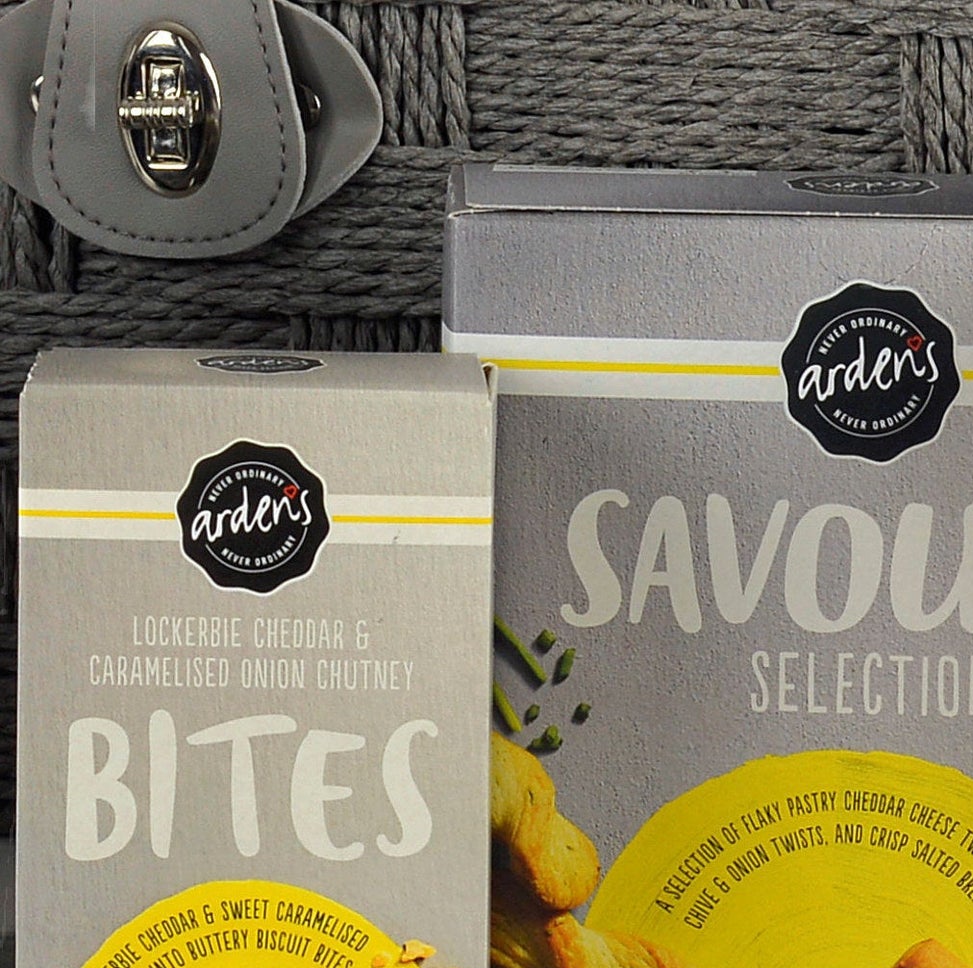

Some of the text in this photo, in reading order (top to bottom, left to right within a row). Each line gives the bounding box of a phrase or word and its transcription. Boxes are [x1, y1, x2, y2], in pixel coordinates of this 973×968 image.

[818, 316, 908, 355] NEVER ORDINARY
[833, 393, 922, 430] NEVER ORDINARY
[208, 468, 285, 503] NEVER ORDINARY
[220, 534, 297, 567] NEVER ORDINARY
[132, 615, 371, 650] LOCKERBIE CHEDDAR &
[89, 655, 415, 691] CARAMELISED ONION CHUTNEY
[65, 709, 439, 862] BITES
[741, 801, 782, 835] FLAKY
[786, 791, 837, 818] PASTRY
[844, 790, 906, 818] CHEDDAR
[909, 802, 961, 840] CHEESE
[721, 822, 741, 845] OF
[663, 835, 725, 901] SELECTION
[684, 887, 721, 930] CHIVE
[712, 876, 731, 894] &
[726, 843, 770, 882] ONION
[834, 823, 863, 844] AND
[869, 825, 909, 853] CRISP
[911, 839, 960, 879] SALTED
[655, 898, 674, 914] A
[138, 909, 199, 952] CHEDDAR
[202, 904, 215, 925] &
[222, 898, 270, 922] SWEET
[276, 900, 370, 952] CARAMELISED
[186, 928, 249, 961] BUTTERY
[256, 928, 313, 958] BISCUIT
